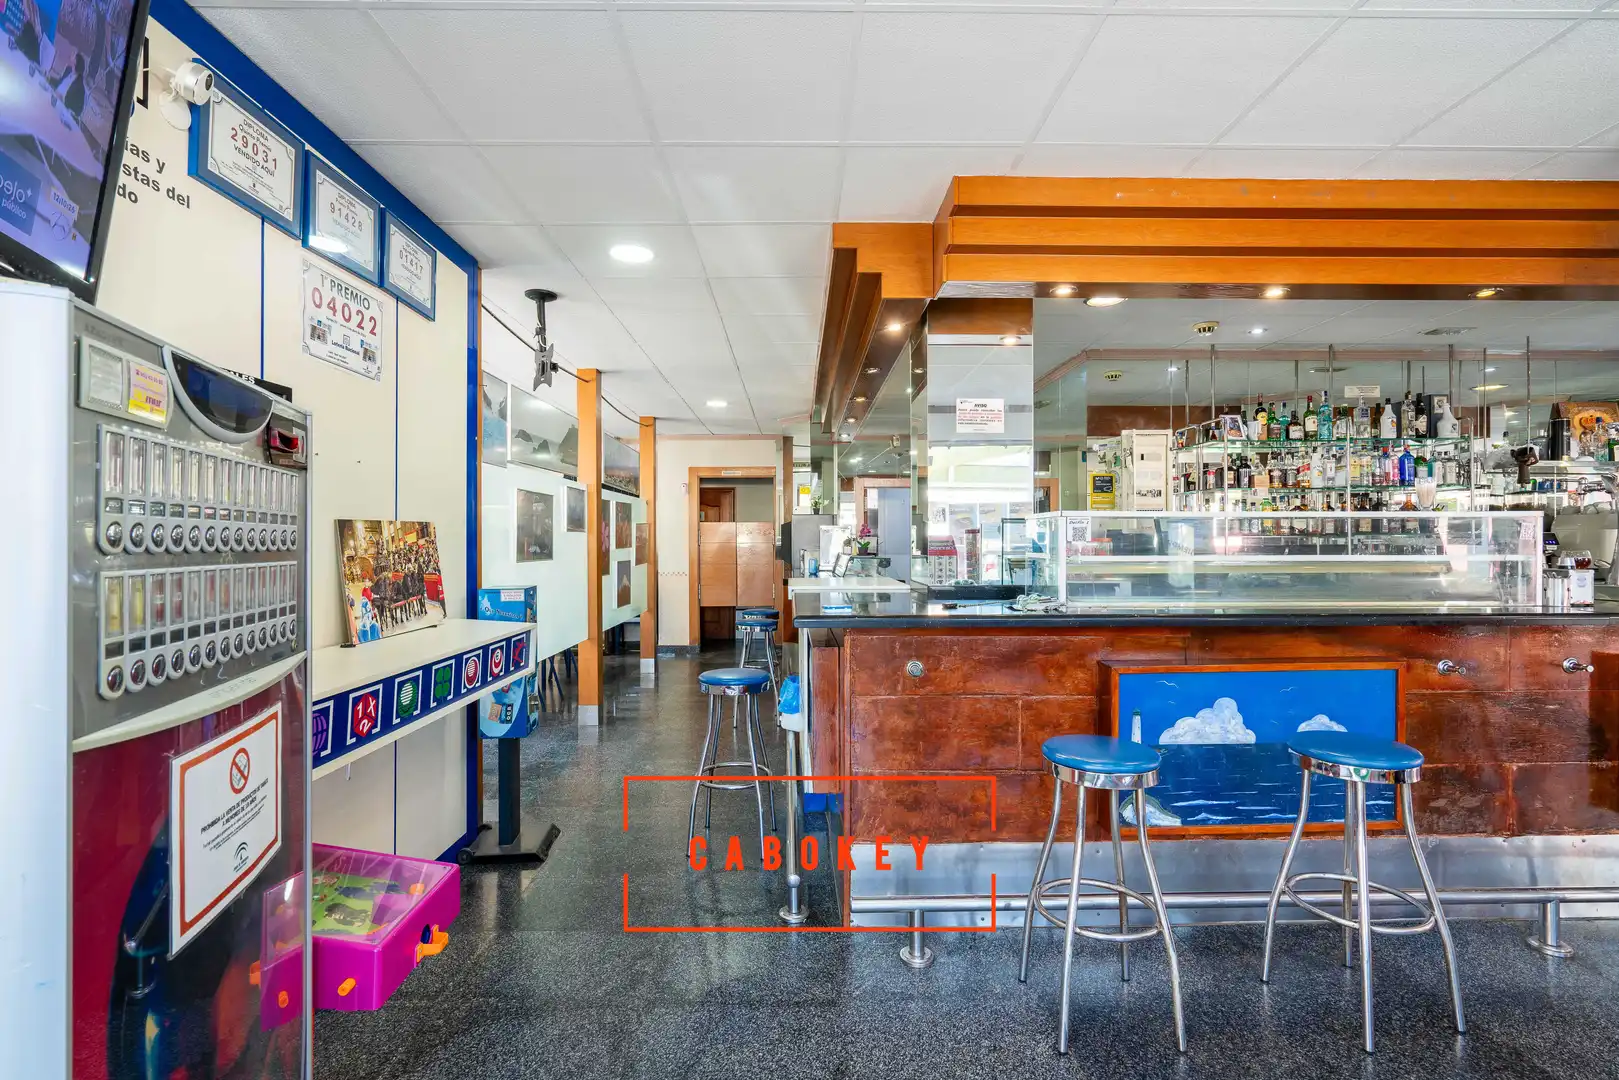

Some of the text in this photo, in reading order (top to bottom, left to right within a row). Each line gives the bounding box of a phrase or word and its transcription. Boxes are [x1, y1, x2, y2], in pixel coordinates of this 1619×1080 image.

[239, 124, 256, 140] Quinto
[244, 119, 269, 142] DIPLOMA
[230, 127, 278, 171] 29031
[234, 144, 260, 167] VENDIDO
[156, 158, 166, 175] y
[117, 182, 139, 204] do
[122, 162, 190, 209] stas del
[2, 198, 26, 219] público
[329, 202, 363, 232] 91428
[400, 249, 424, 273] 01417
[330, 279, 371, 311] PREMIO
[312, 286, 377, 337] 04022
[200, 817, 221, 835] PROHIBIDA
[220, 812, 226, 820] LA
[226, 805, 236, 816] VENTA
